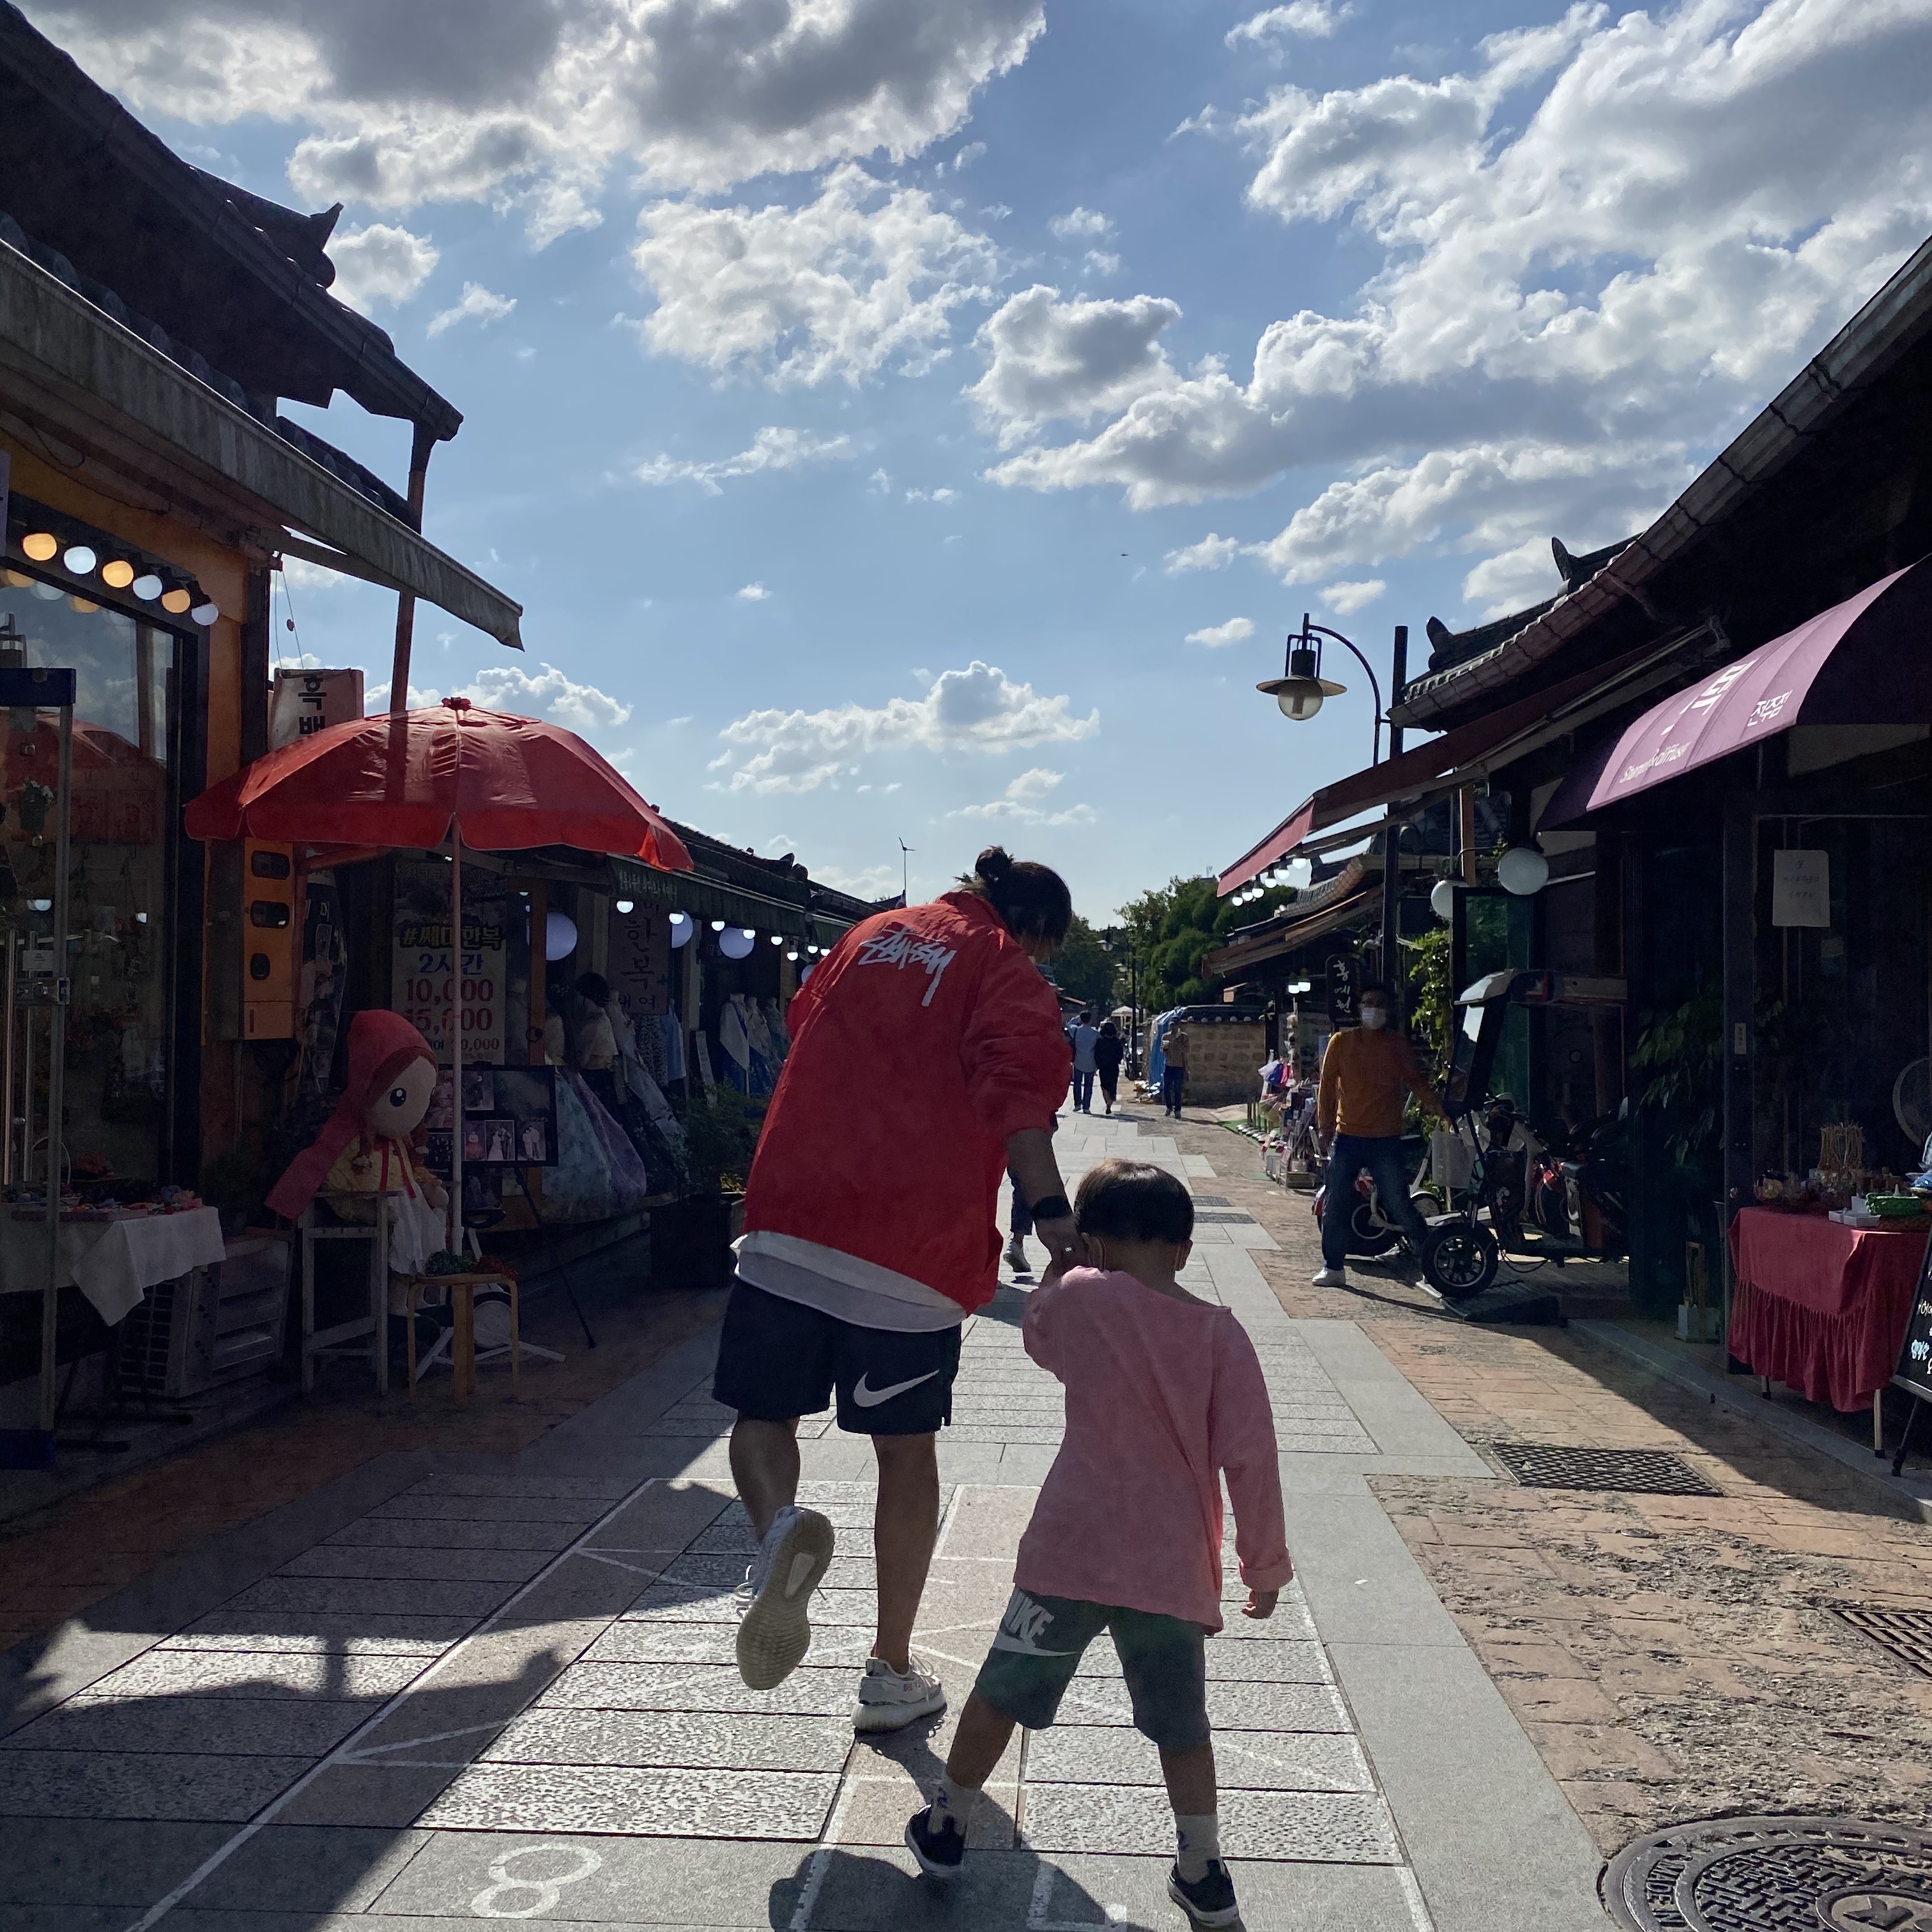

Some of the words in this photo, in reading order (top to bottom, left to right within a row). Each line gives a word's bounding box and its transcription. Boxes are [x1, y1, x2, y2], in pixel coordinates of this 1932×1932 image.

[1747, 689, 1793, 726] 전주점
[620, 917, 657, 990] 한복
[406, 978, 494, 1005] 10,000
[1003, 1587, 1054, 1642] NIKE
[470, 1843, 602, 1919] 8
[1645, 1860, 1685, 1905] MADE
